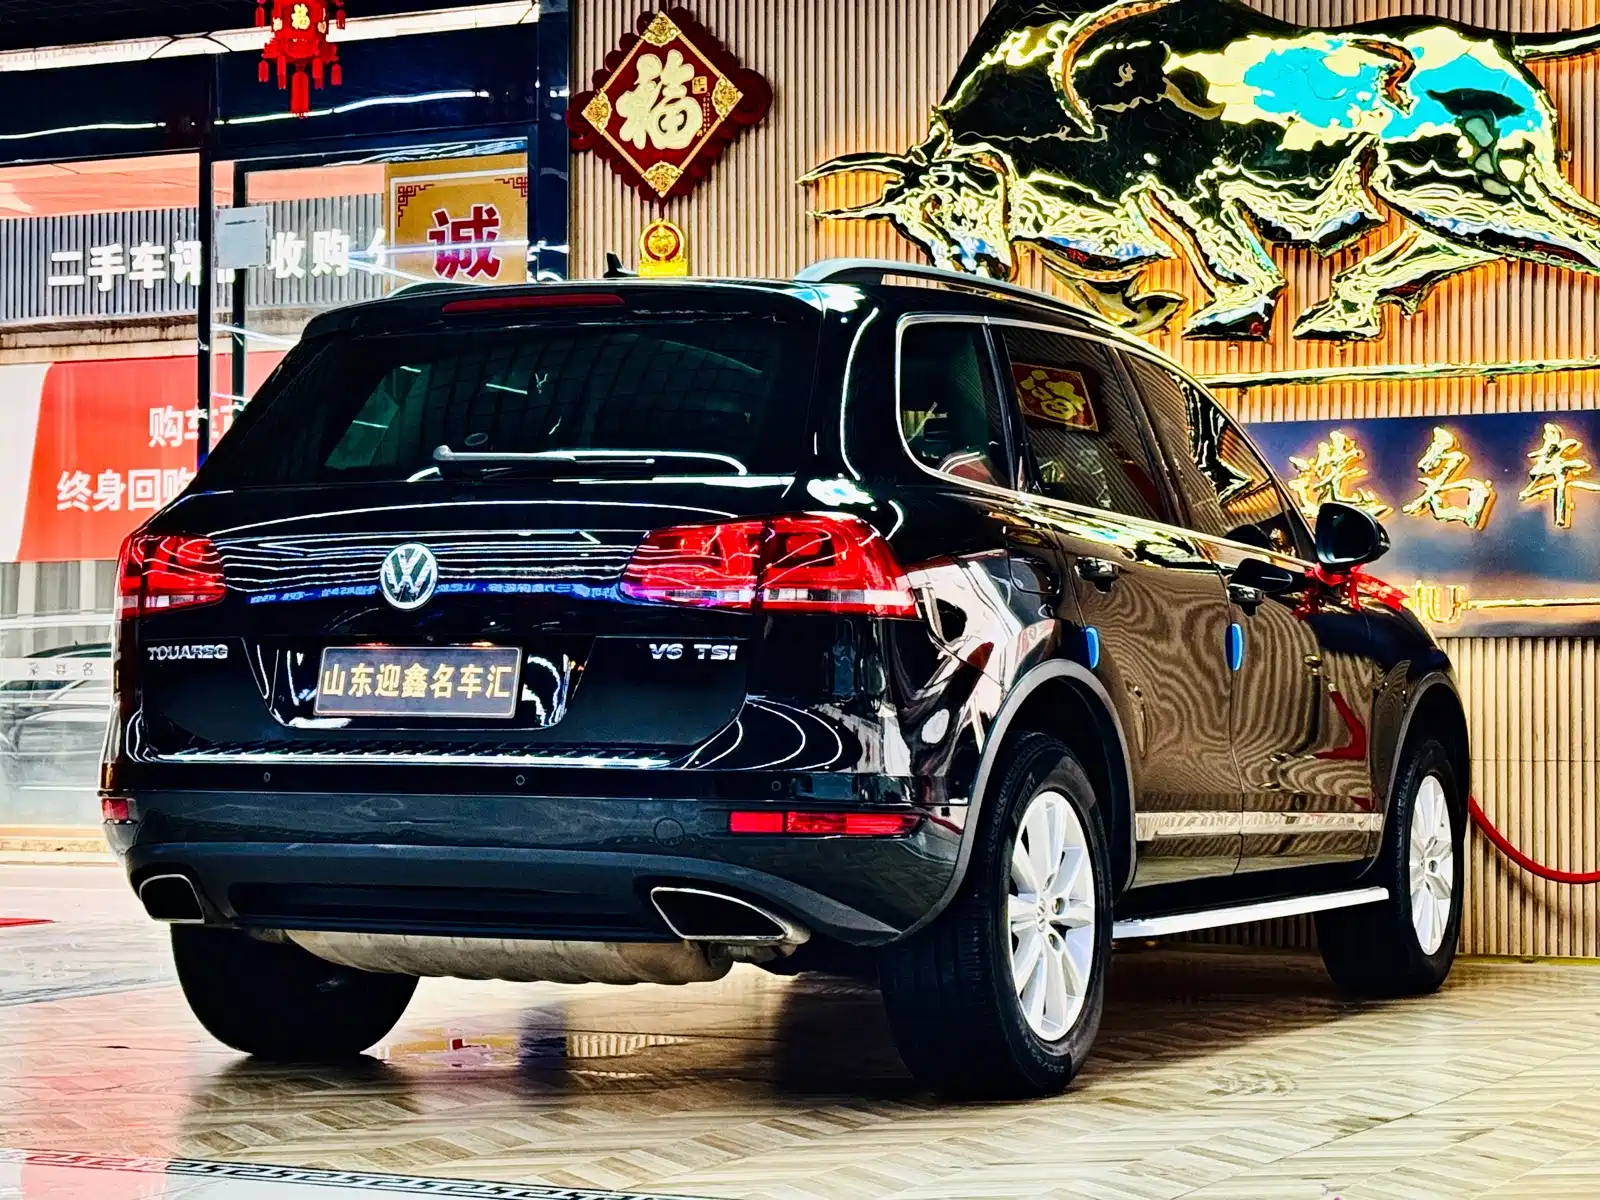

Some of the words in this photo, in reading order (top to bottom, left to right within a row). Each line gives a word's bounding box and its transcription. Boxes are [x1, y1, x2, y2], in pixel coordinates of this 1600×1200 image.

[615, 49, 704, 150] 福
[427, 203, 501, 281] 诚
[147, 644, 229, 661] TOUAREG
[649, 643, 684, 660] V6
[693, 644, 738, 661] TSI
[322, 662, 513, 699] 山东迎鑫名车汇
